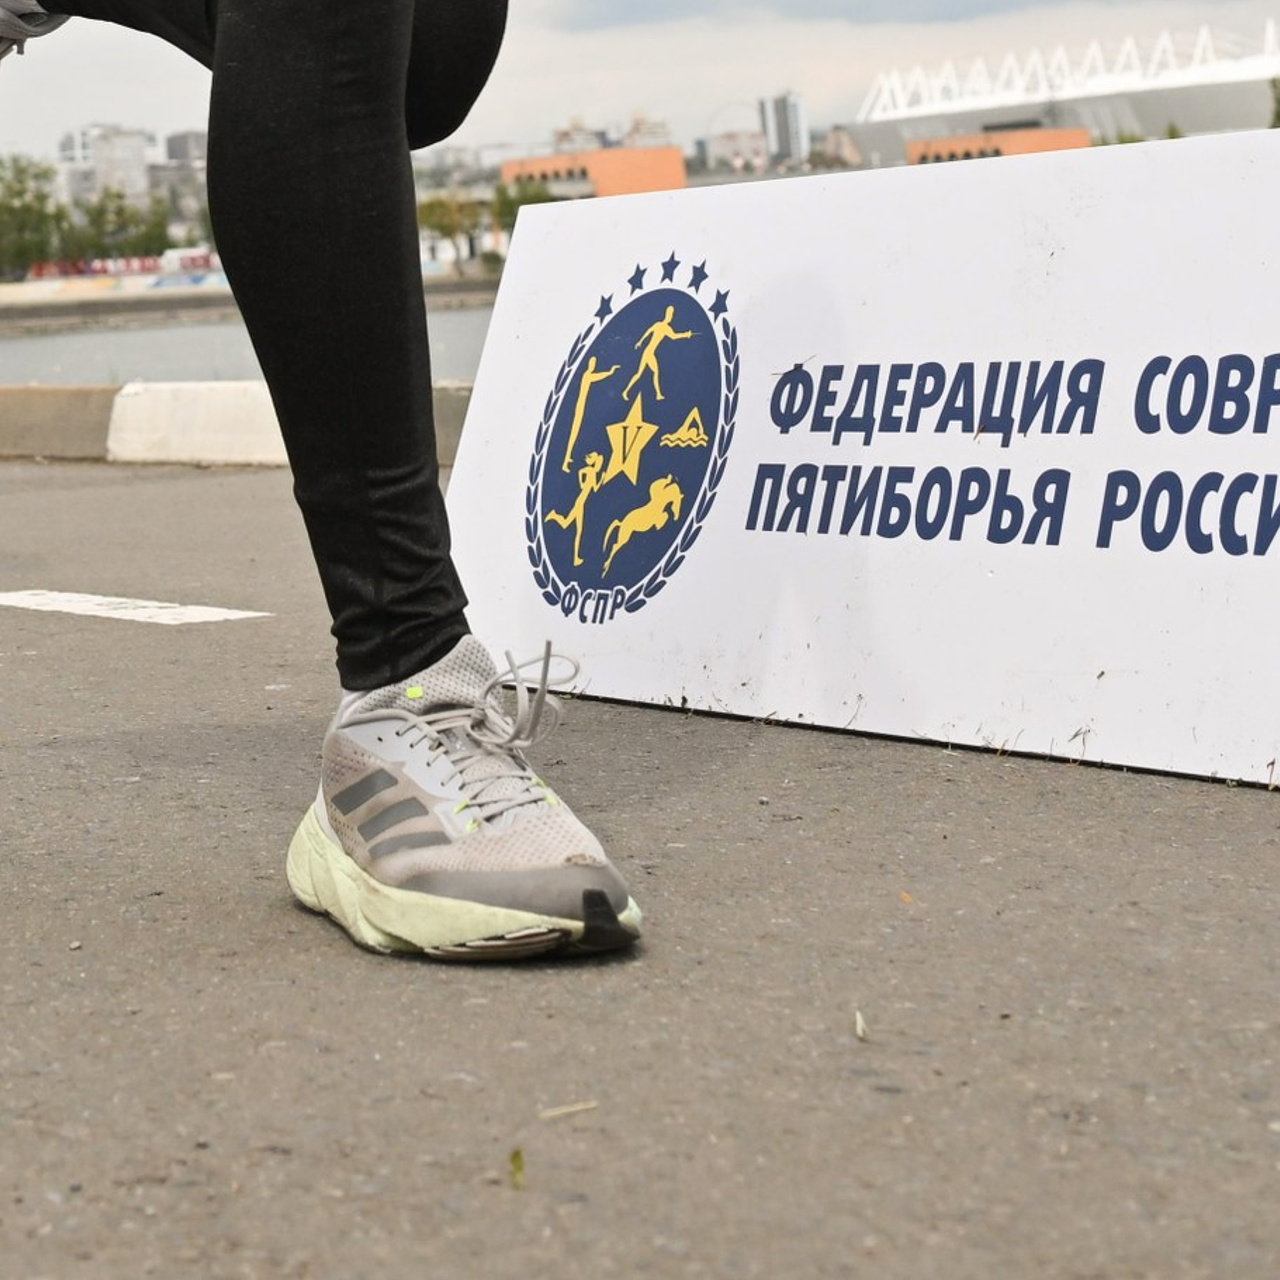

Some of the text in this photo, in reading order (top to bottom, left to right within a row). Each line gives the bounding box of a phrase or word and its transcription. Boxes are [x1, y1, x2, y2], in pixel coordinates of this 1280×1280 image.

[770, 359, 1105, 448] ФЕДЕРАЦИЯ
[745, 463, 1071, 546] ПЯТИБОРЬЯ
[561, 584, 626, 624] ФСПР
